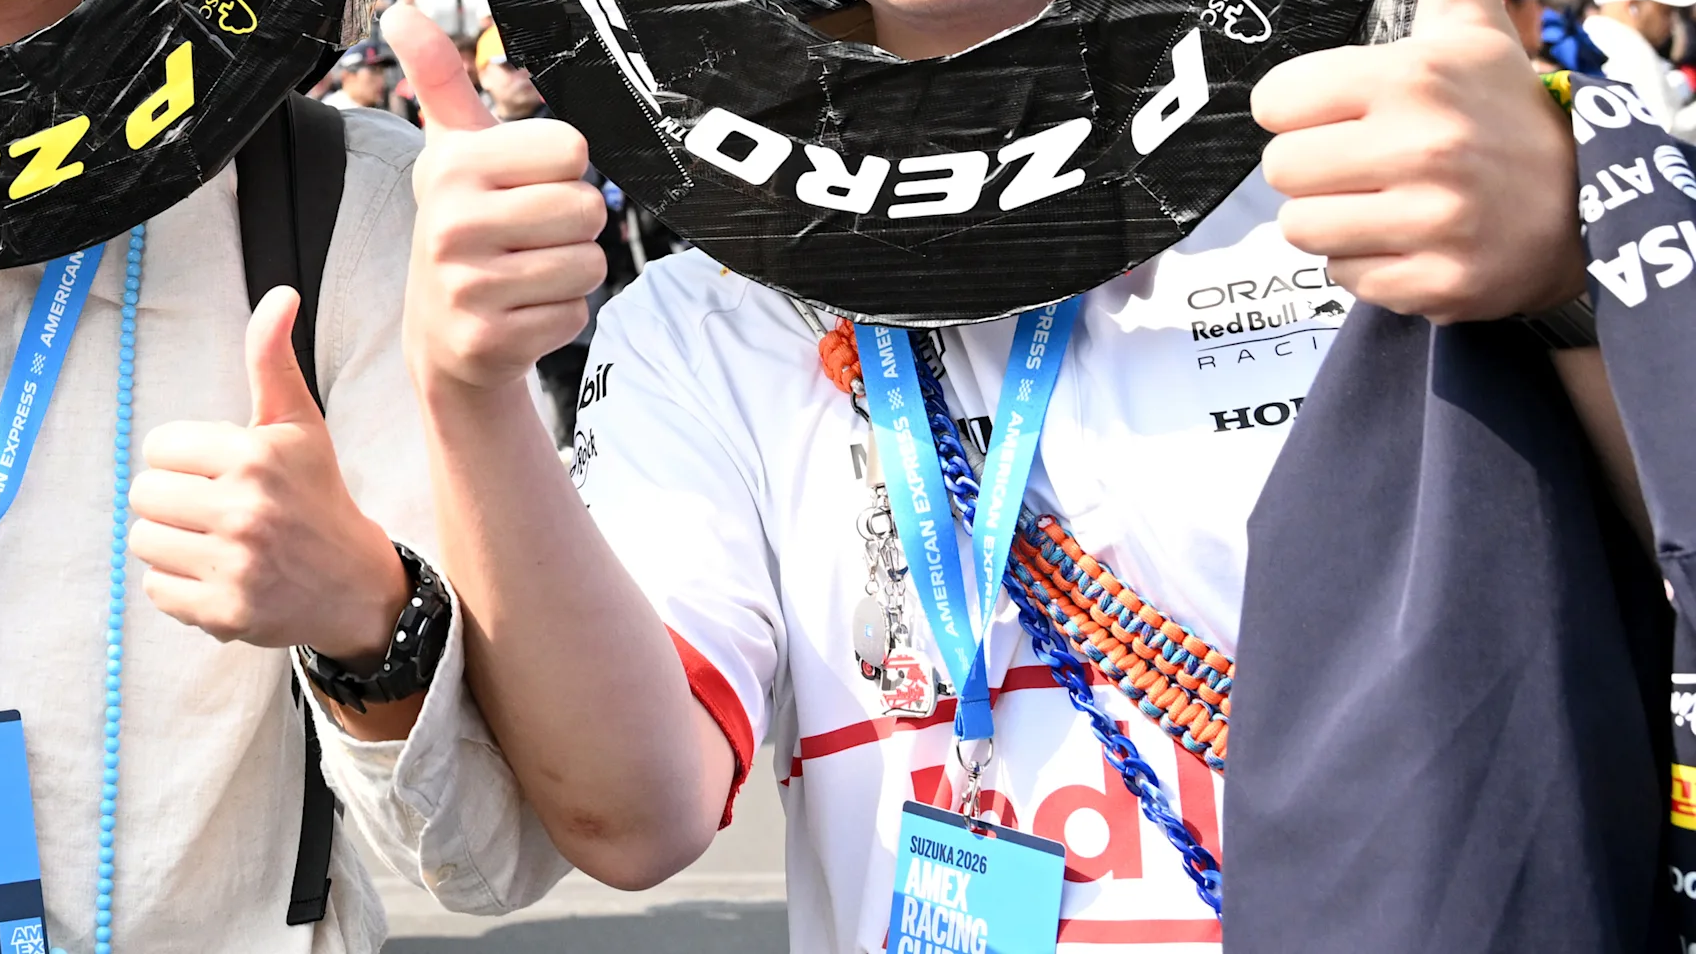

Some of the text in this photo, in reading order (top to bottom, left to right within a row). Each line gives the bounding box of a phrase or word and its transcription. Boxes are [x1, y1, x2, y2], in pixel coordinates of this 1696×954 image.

[125, 40, 195, 150] P
[1131, 27, 1209, 155] P
[1579, 157, 1654, 237] AT&
[40, 251, 85, 348] AMERICAN
[1187, 267, 1342, 310] ORACL
[1587, 220, 1696, 308] ISA
[875, 326, 899, 378] AMER
[1026, 304, 1057, 370] PRESS
[1197, 336, 1317, 370] RACI
[0, 380, 37, 471] EXPRESS
[893, 416, 959, 638] AMERICAN EXPRESS
[983, 411, 1023, 621] AMERICAN EXPRE
[904, 858, 971, 912] AMEX
[910, 835, 987, 874] SUZUKA 2026
[901, 896, 988, 954] RACING
